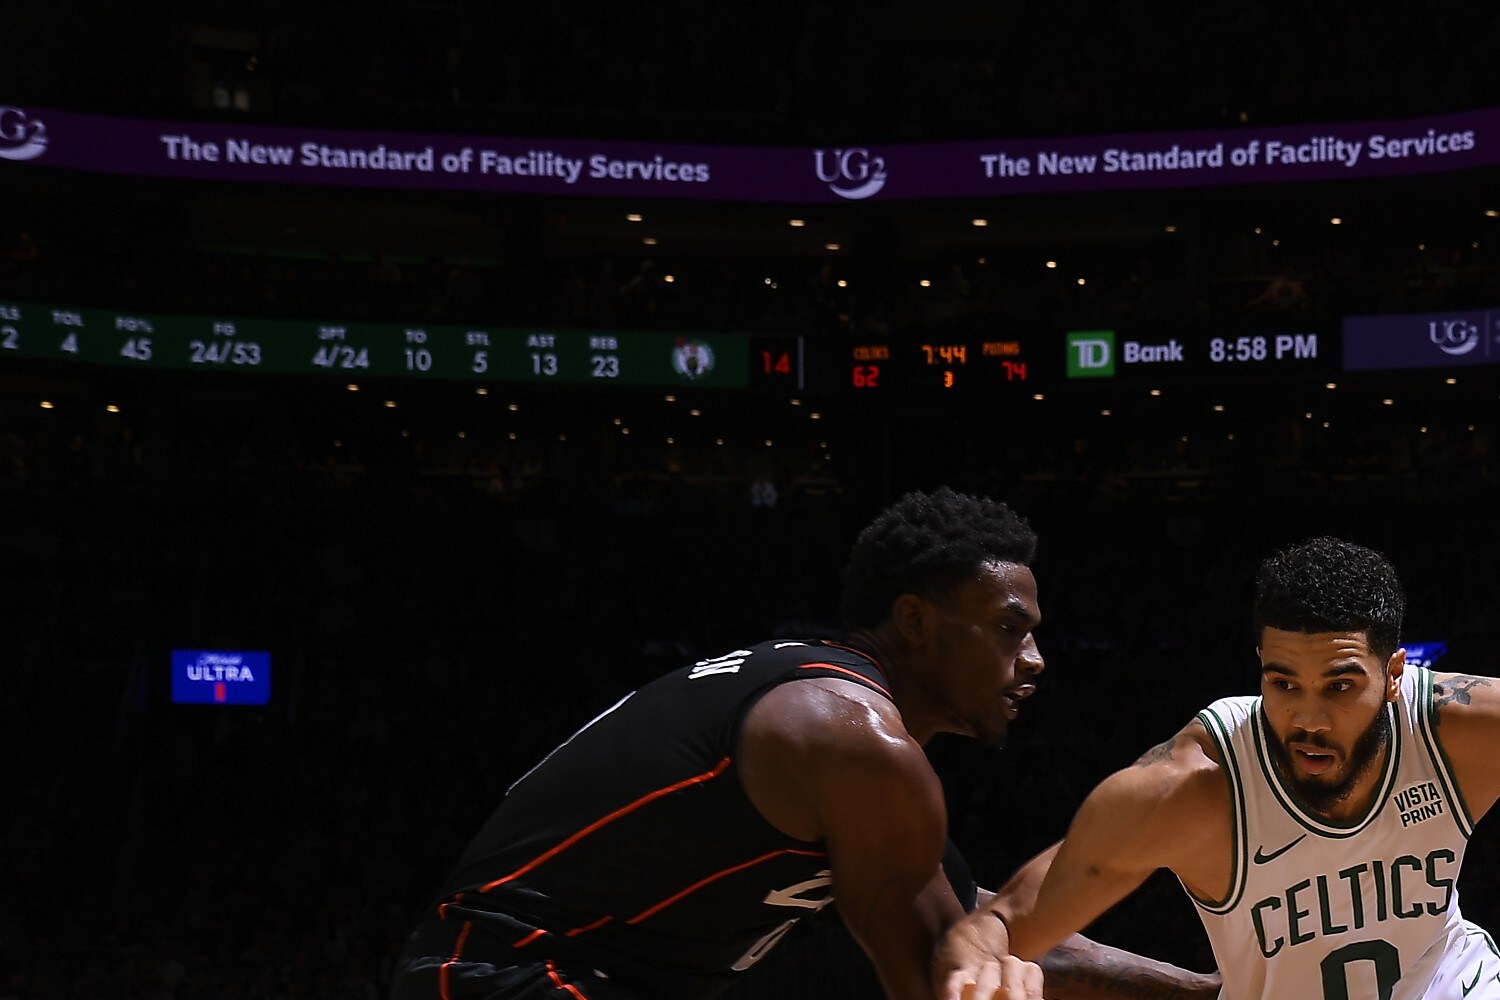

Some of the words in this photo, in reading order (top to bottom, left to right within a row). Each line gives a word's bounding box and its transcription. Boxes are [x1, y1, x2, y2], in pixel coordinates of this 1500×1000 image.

[160, 134, 220, 162] The
[225, 138, 295, 167] New
[299, 142, 434, 172] Standard
[440, 147, 473, 173] of
[479, 150, 583, 184] Facility
[588, 153, 711, 183] Services
[813, 147, 887, 183] UG2
[980, 153, 1031, 179] The
[1036, 150, 1097, 176] New
[1102, 142, 1224, 174] Standard
[1229, 140, 1260, 168] of
[1264, 136, 1362, 168] Facility
[1367, 129, 1475, 160] Services
[60, 331, 79, 354] 4
[119, 337, 153, 362] 45
[189, 339, 262, 366] 24/53
[526, 334, 557, 349] AST
[1070, 338, 1112, 369] TD
[1122, 340, 1184, 364] Bank
[1208, 336, 1268, 363] 8:58
[1273, 333, 1319, 361] PM
[311, 344, 371, 370] 4/24
[403, 348, 432, 373] 10
[471, 350, 489, 375] 5
[530, 352, 559, 377] 13
[590, 354, 620, 379] 23
[761, 350, 793, 375] 14
[852, 364, 880, 388] 62
[943, 370, 954, 388] 3
[1001, 360, 1028, 382] 74
[186, 664, 255, 682] ULTRA
[1394, 782, 1441, 813] VISTA
[1401, 800, 1445, 828] PRINT
[1250, 848, 1456, 959] CELTICS
